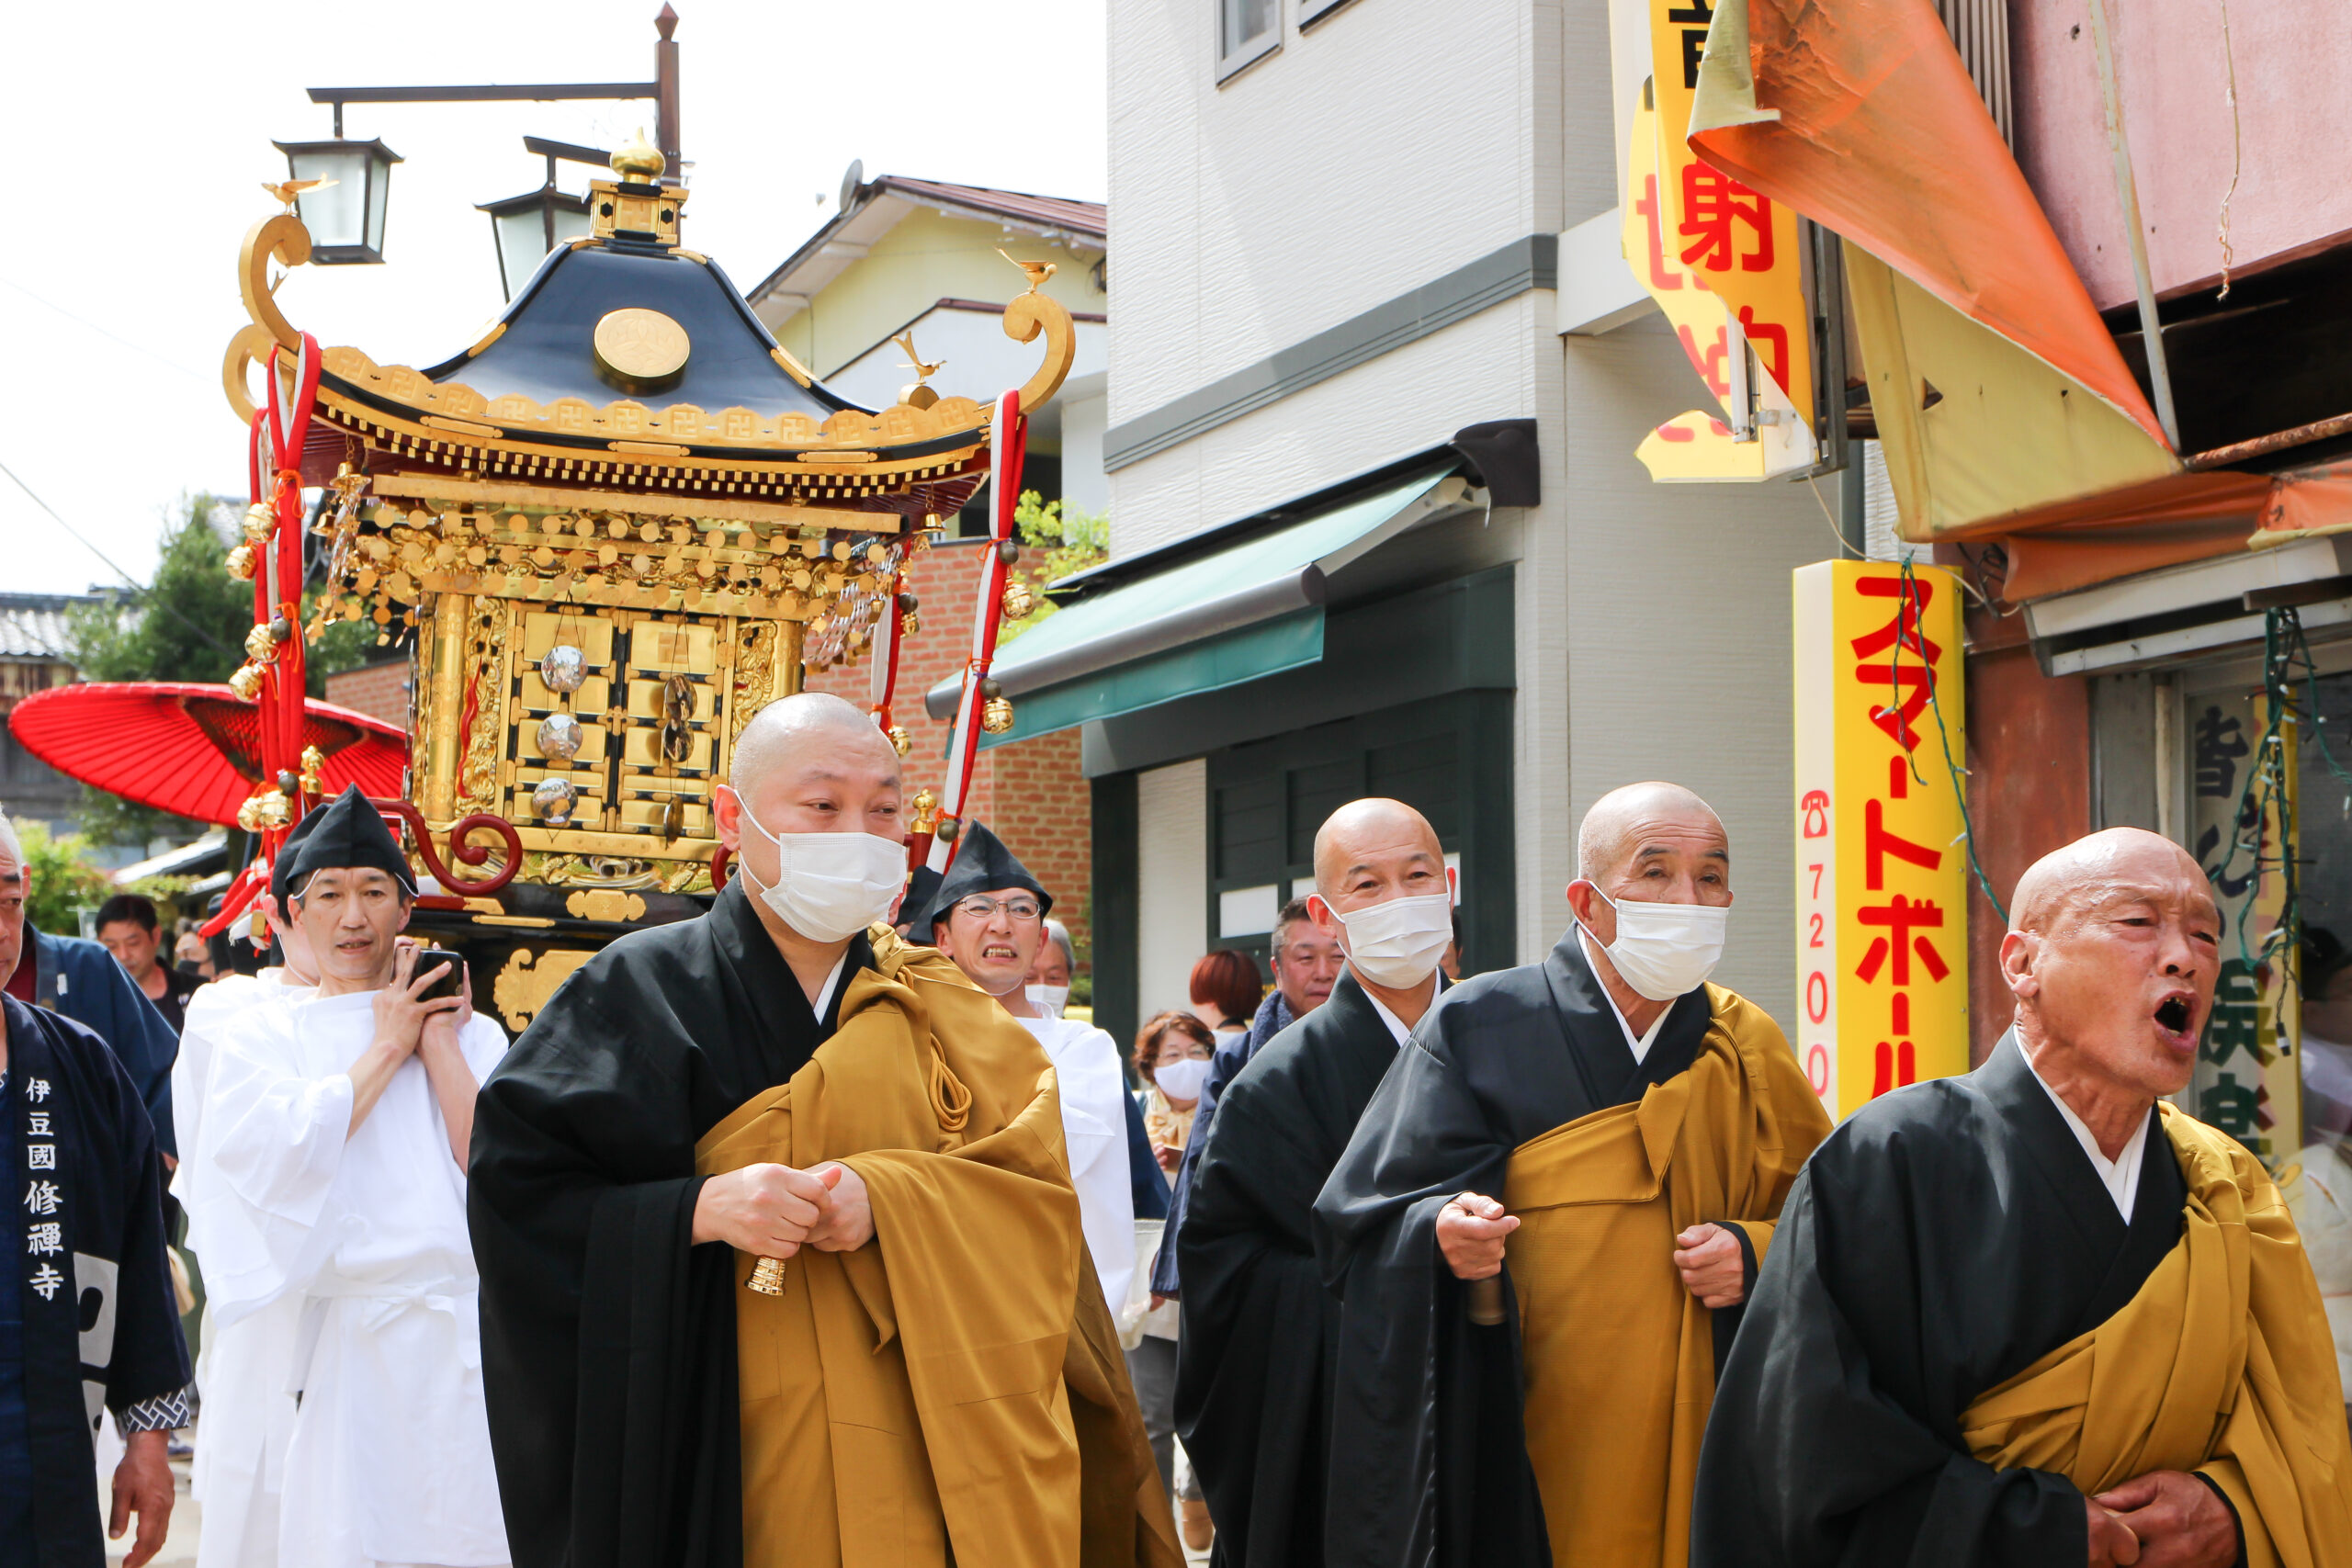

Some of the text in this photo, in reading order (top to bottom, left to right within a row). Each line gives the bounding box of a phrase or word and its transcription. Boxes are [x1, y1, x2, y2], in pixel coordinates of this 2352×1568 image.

[1807, 863, 1828, 1098] 7200
[25, 1077, 63, 1301] 伊豆國修禪寺
